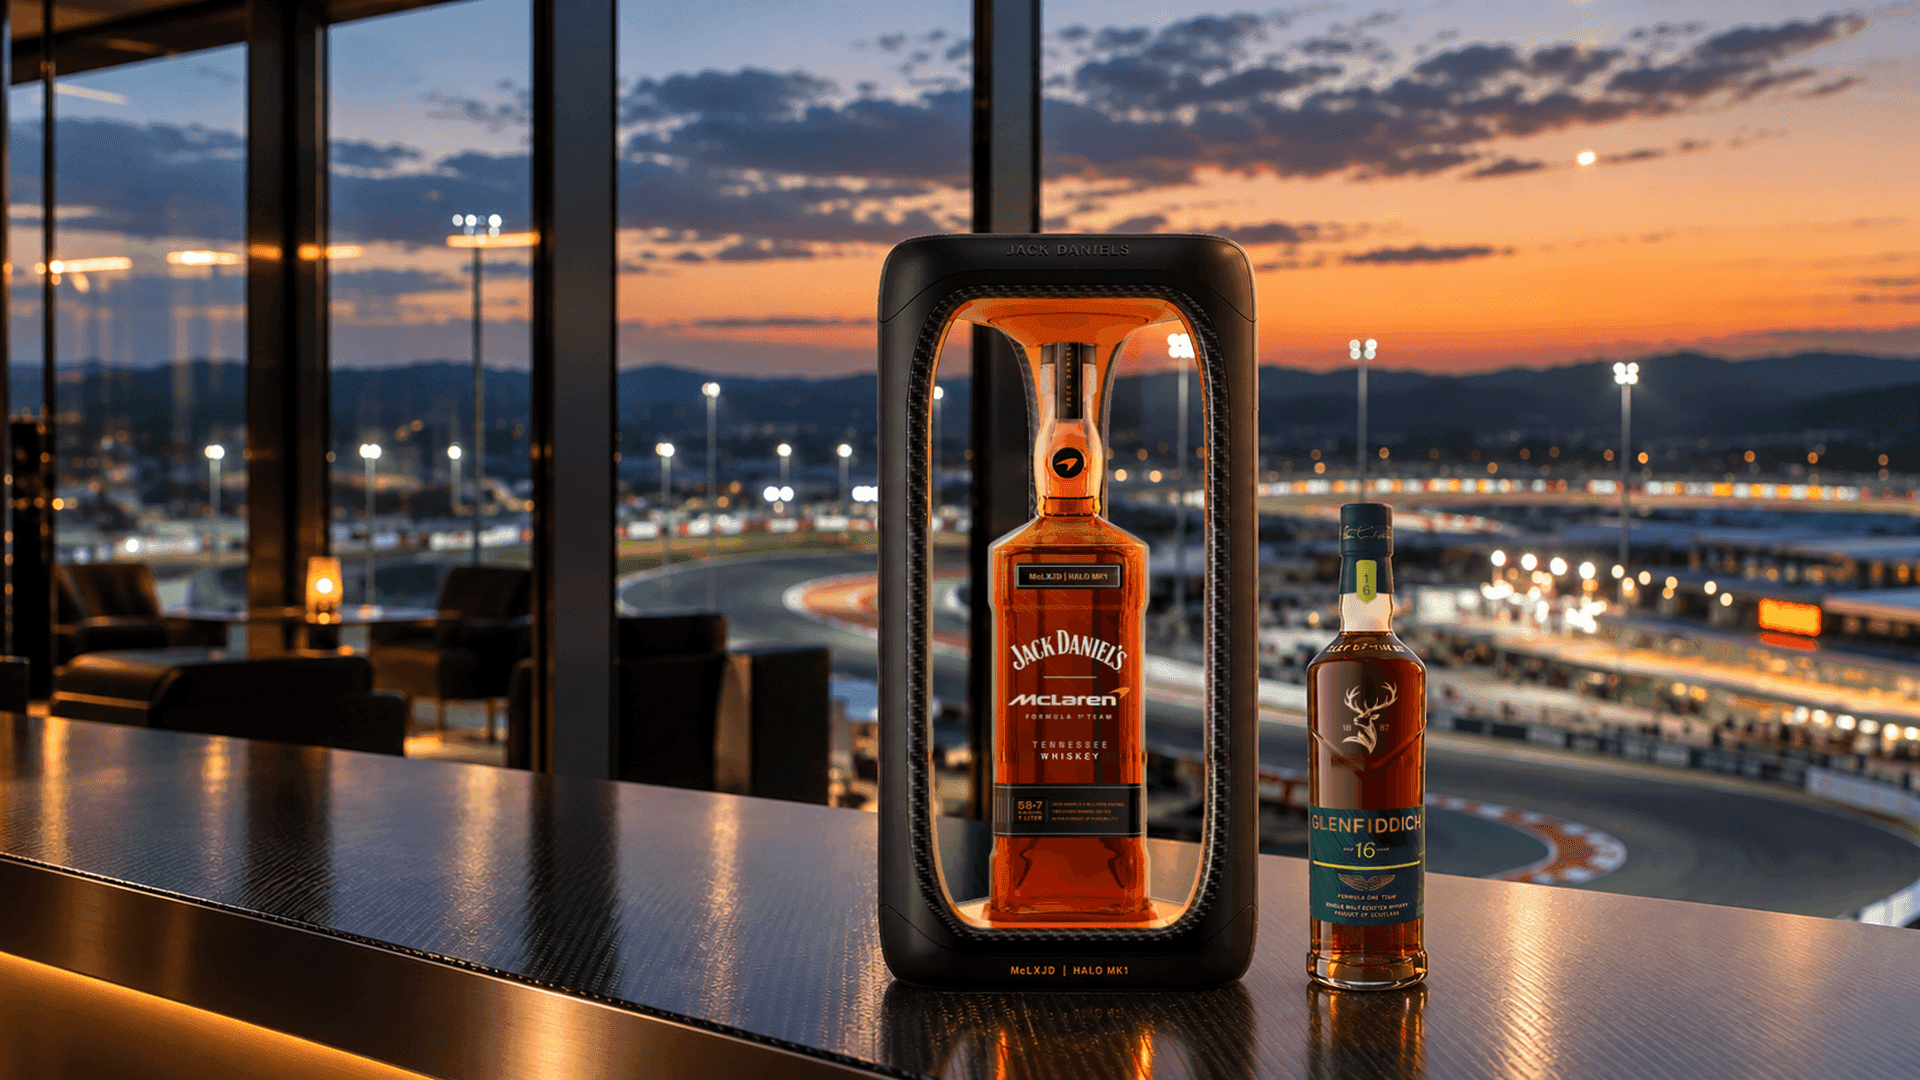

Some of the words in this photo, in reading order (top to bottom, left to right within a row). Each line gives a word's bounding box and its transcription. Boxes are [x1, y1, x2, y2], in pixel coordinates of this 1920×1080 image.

[1006, 244, 1049, 257] JACK
[1057, 244, 1130, 257] DANIELS
[1029, 572, 1062, 581] McLXJD
[1010, 635, 1056, 671] JACK
[1056, 629, 1128, 671] DANIEL'S
[1008, 694, 1117, 706] McLaren
[1032, 741, 1108, 749] TENNESSEE
[1312, 814, 1422, 834] GLENFIDDICH
[1356, 842, 1376, 859] 16
[1010, 966, 1056, 975] McLXJD
[1073, 966, 1103, 975] HALO
[1106, 966, 1129, 975] MK1
